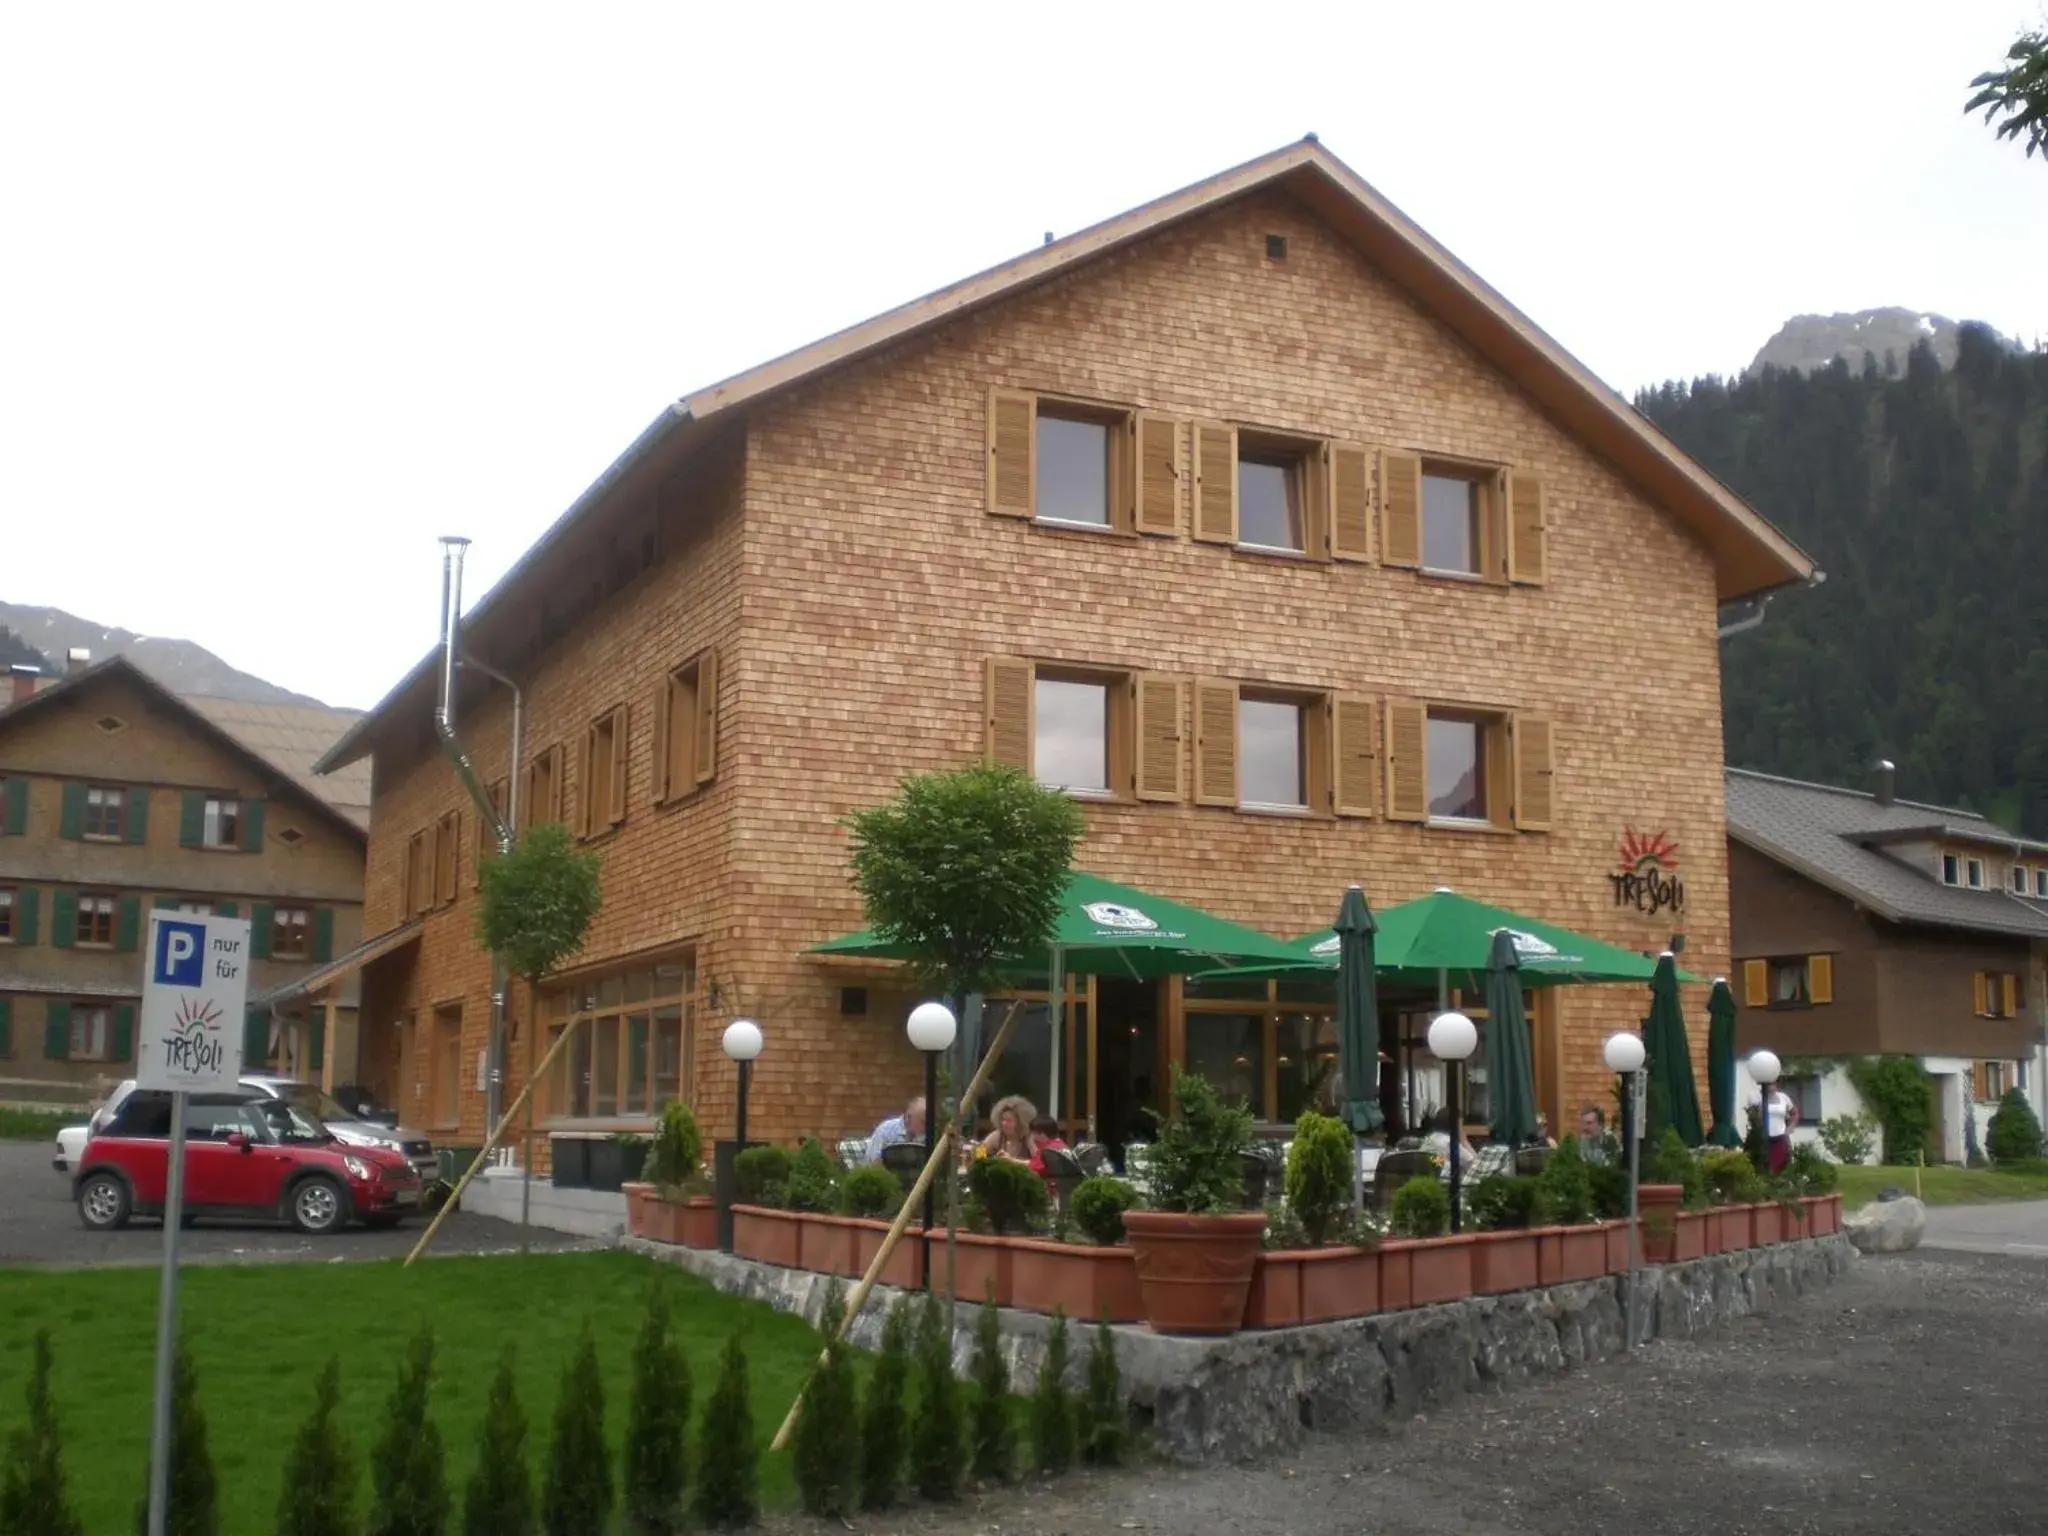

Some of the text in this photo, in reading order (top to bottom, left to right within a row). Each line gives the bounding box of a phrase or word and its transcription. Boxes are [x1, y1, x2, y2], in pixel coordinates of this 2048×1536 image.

[164, 930, 194, 976] P
[213, 938, 240, 952] nur
[215, 959, 238, 979] für
